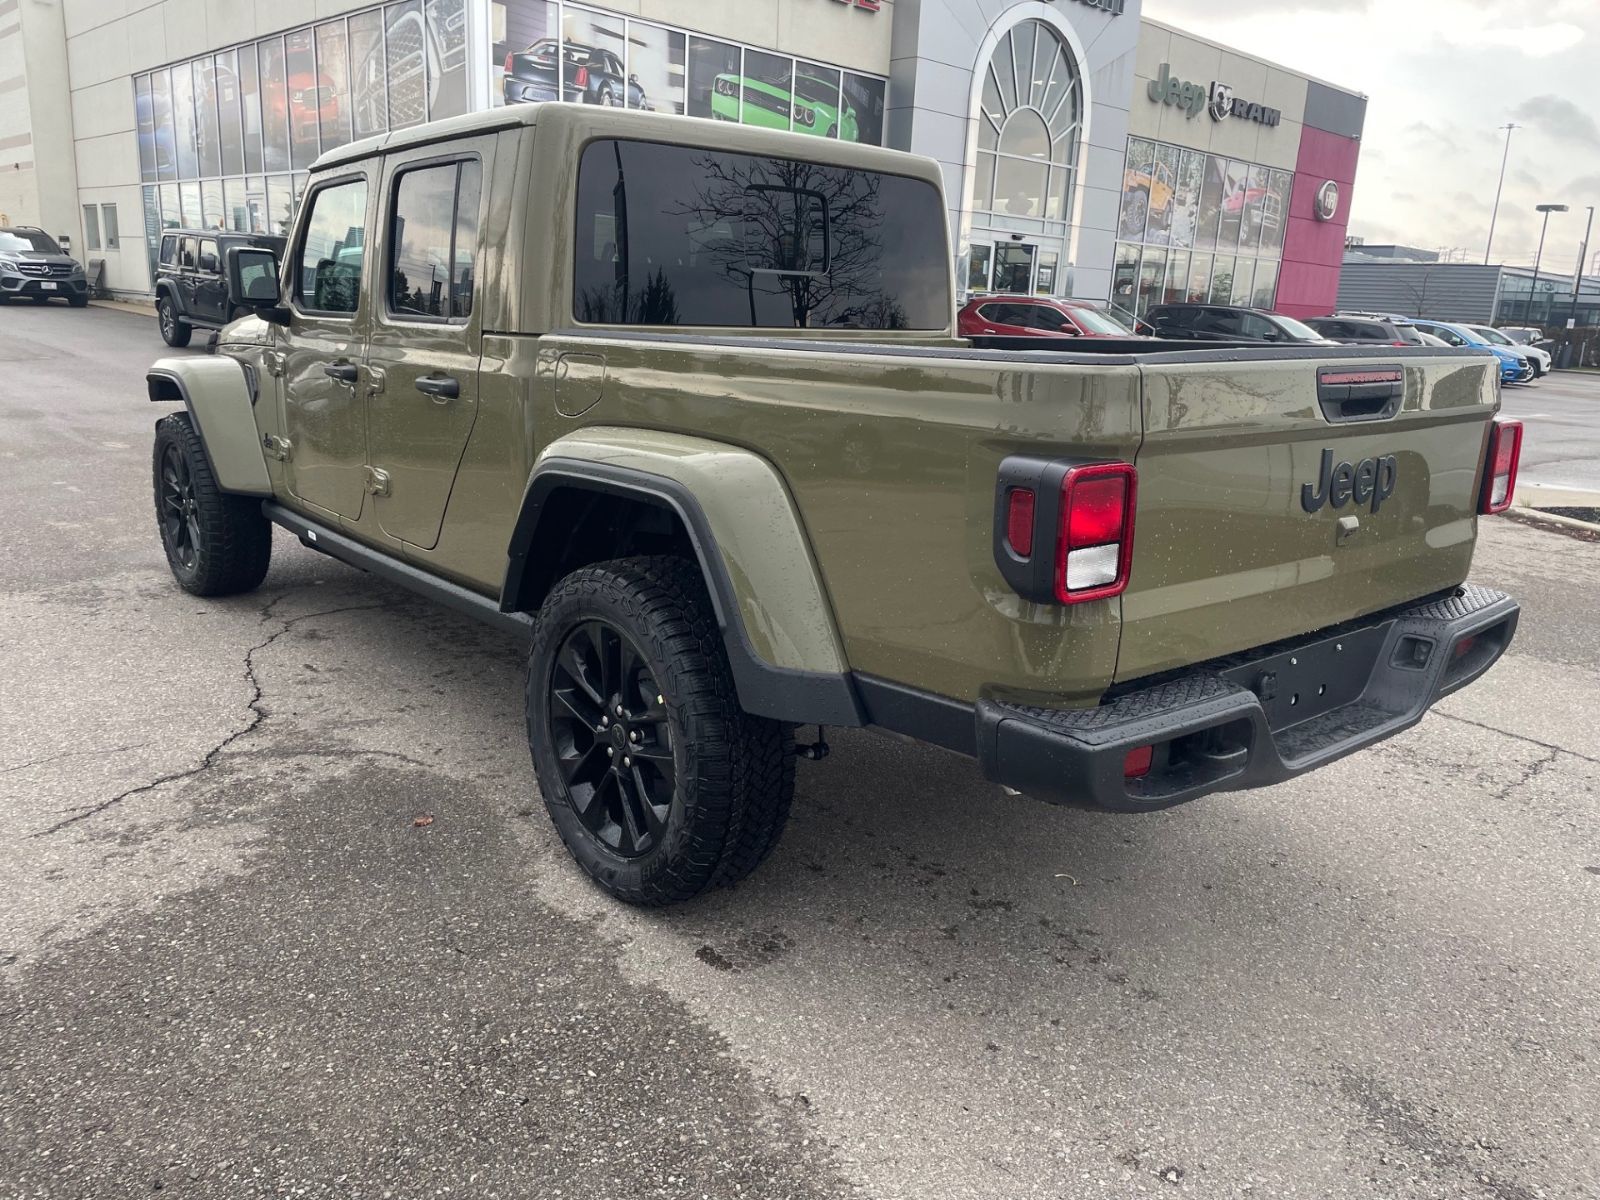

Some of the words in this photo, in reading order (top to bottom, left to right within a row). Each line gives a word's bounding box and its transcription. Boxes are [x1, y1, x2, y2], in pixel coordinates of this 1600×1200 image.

[1147, 63, 1206, 119] Jeep
[1231, 98, 1281, 127] RAM
[1301, 448, 1397, 514] Jeep
